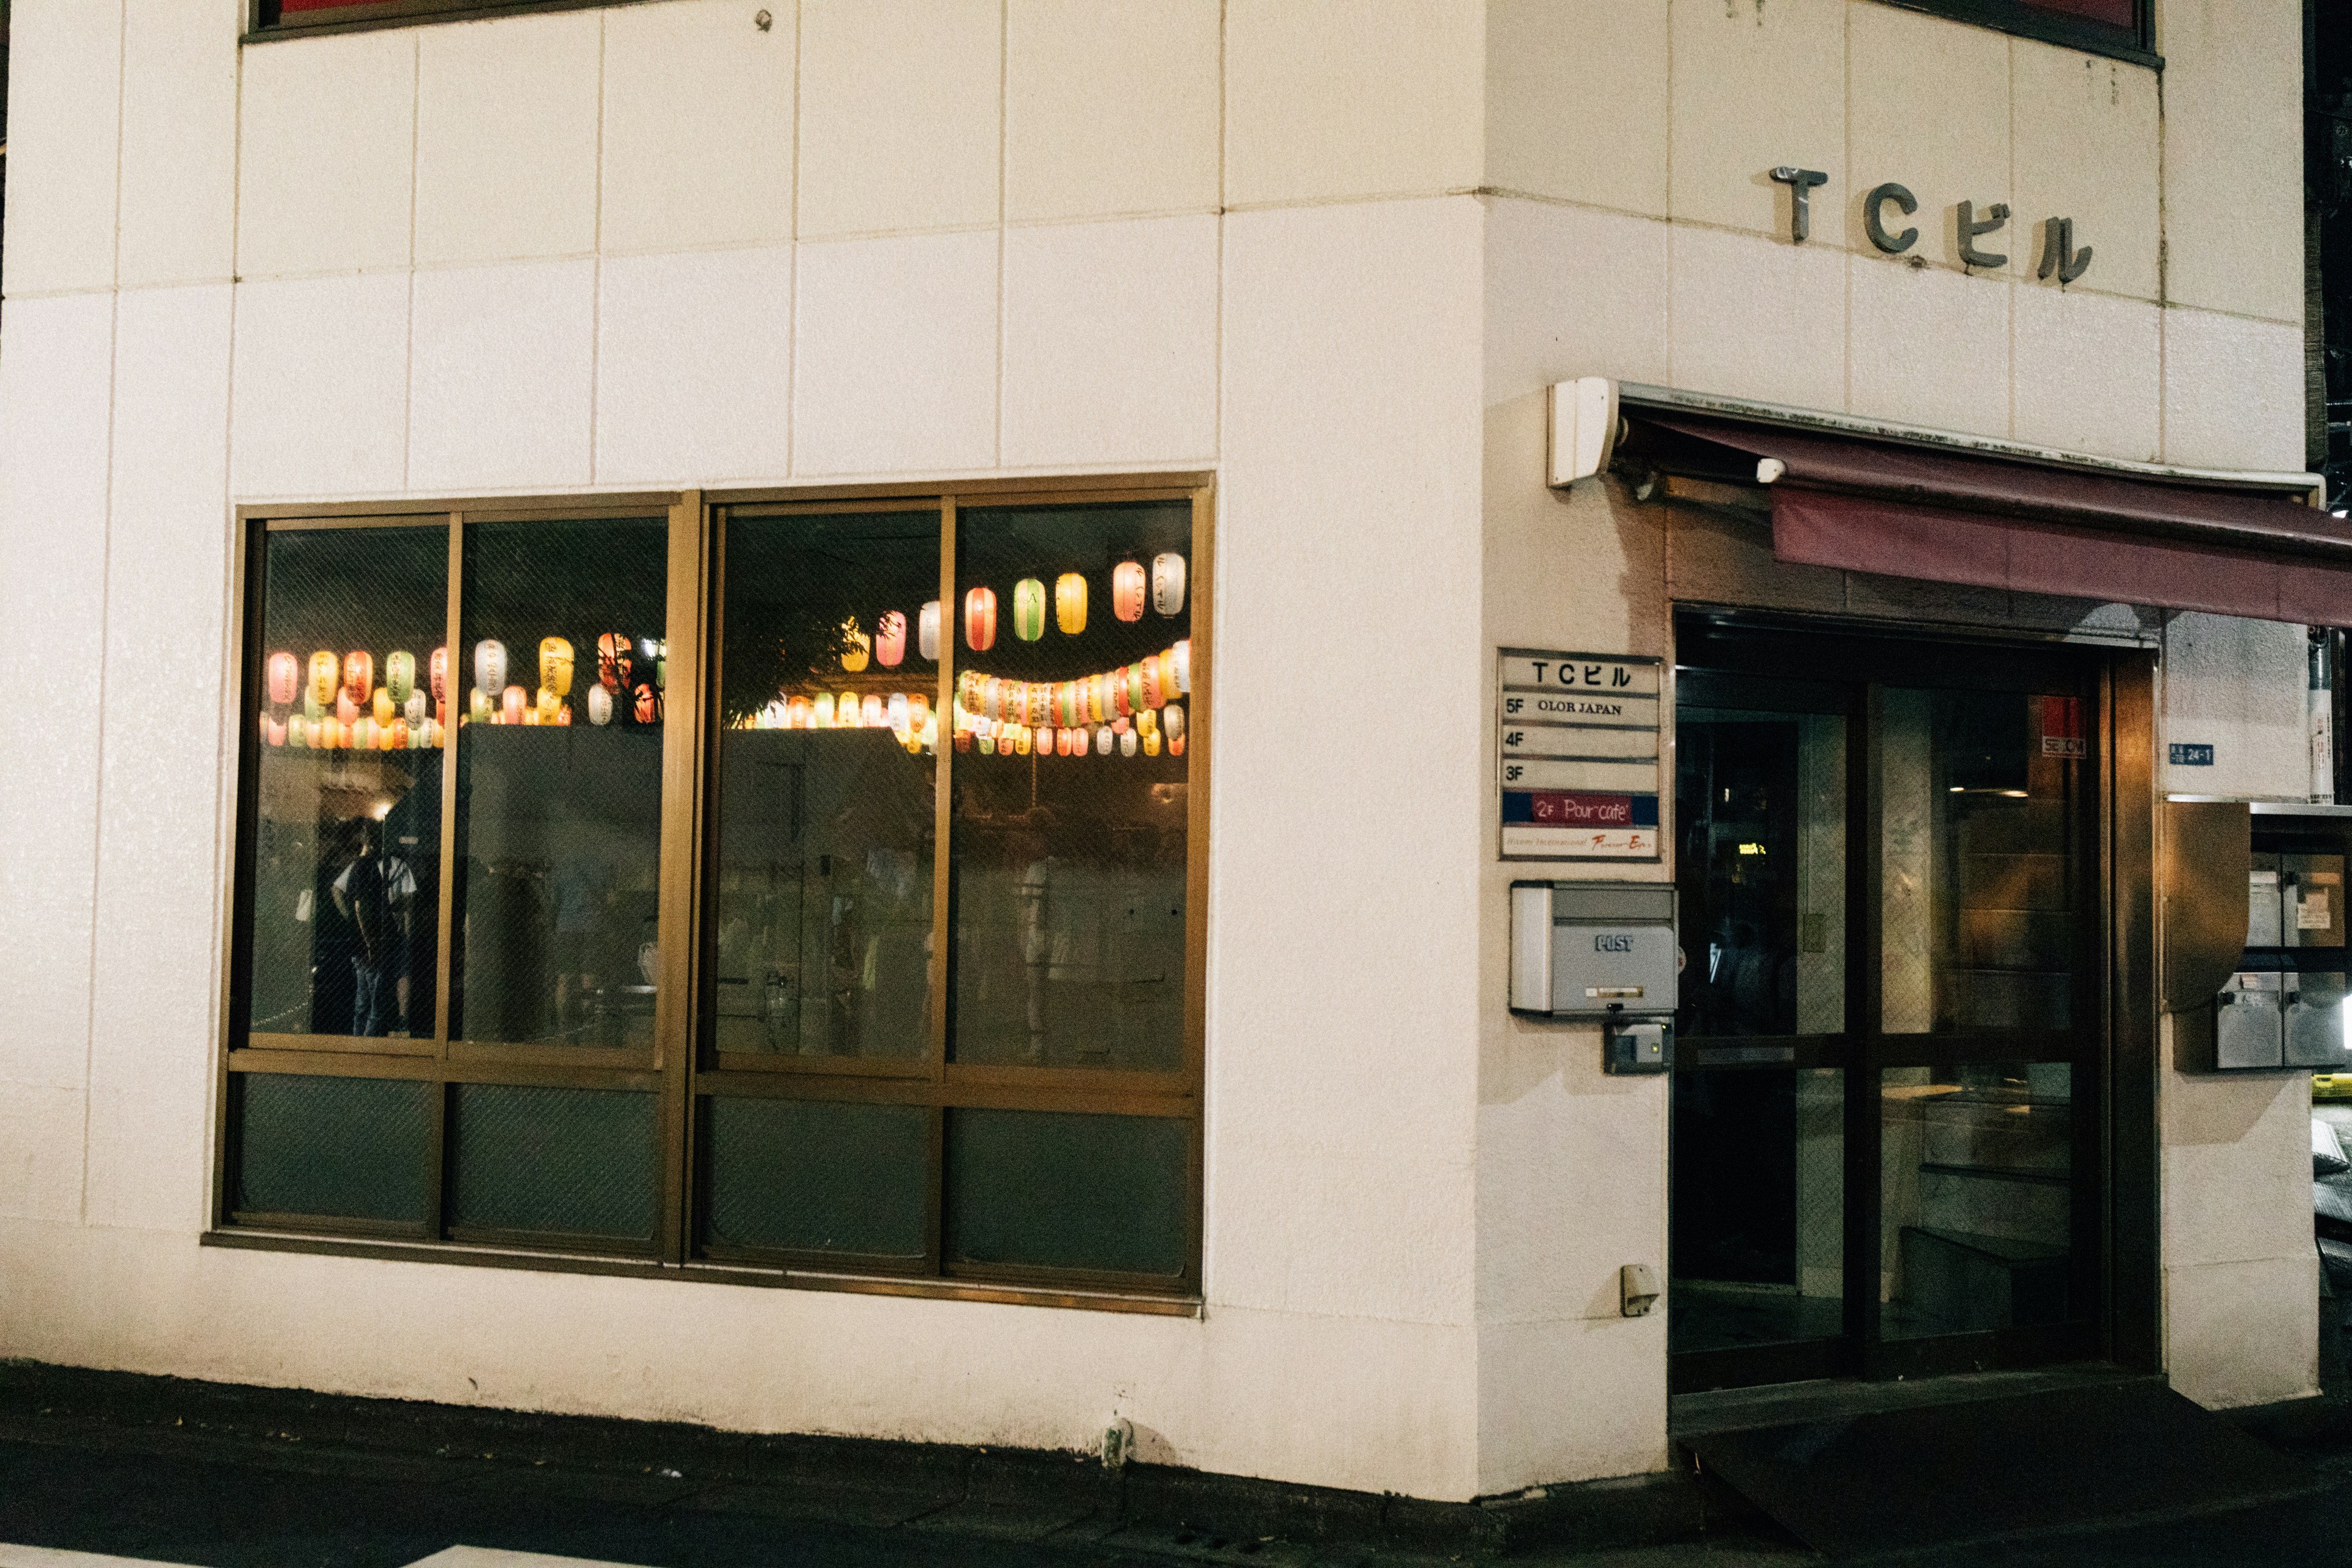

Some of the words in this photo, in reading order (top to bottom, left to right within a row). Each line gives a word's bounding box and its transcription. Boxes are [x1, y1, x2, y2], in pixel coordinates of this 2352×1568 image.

[1769, 166, 2093, 283] TCビル
[1532, 662, 1631, 687] TCビル
[1506, 698, 1523, 713] 5F
[1538, 700, 1576, 712] OLOR
[1579, 704, 1622, 715] JAPAN
[1506, 732, 1524, 747] 4F
[2045, 738, 2084, 753] SEOM
[2188, 748, 2211, 761] 24-1
[1506, 766, 1523, 780] 3F
[1537, 801, 1554, 817] 2F
[1564, 799, 1592, 819] Pour
[1595, 934, 1634, 951] POST
